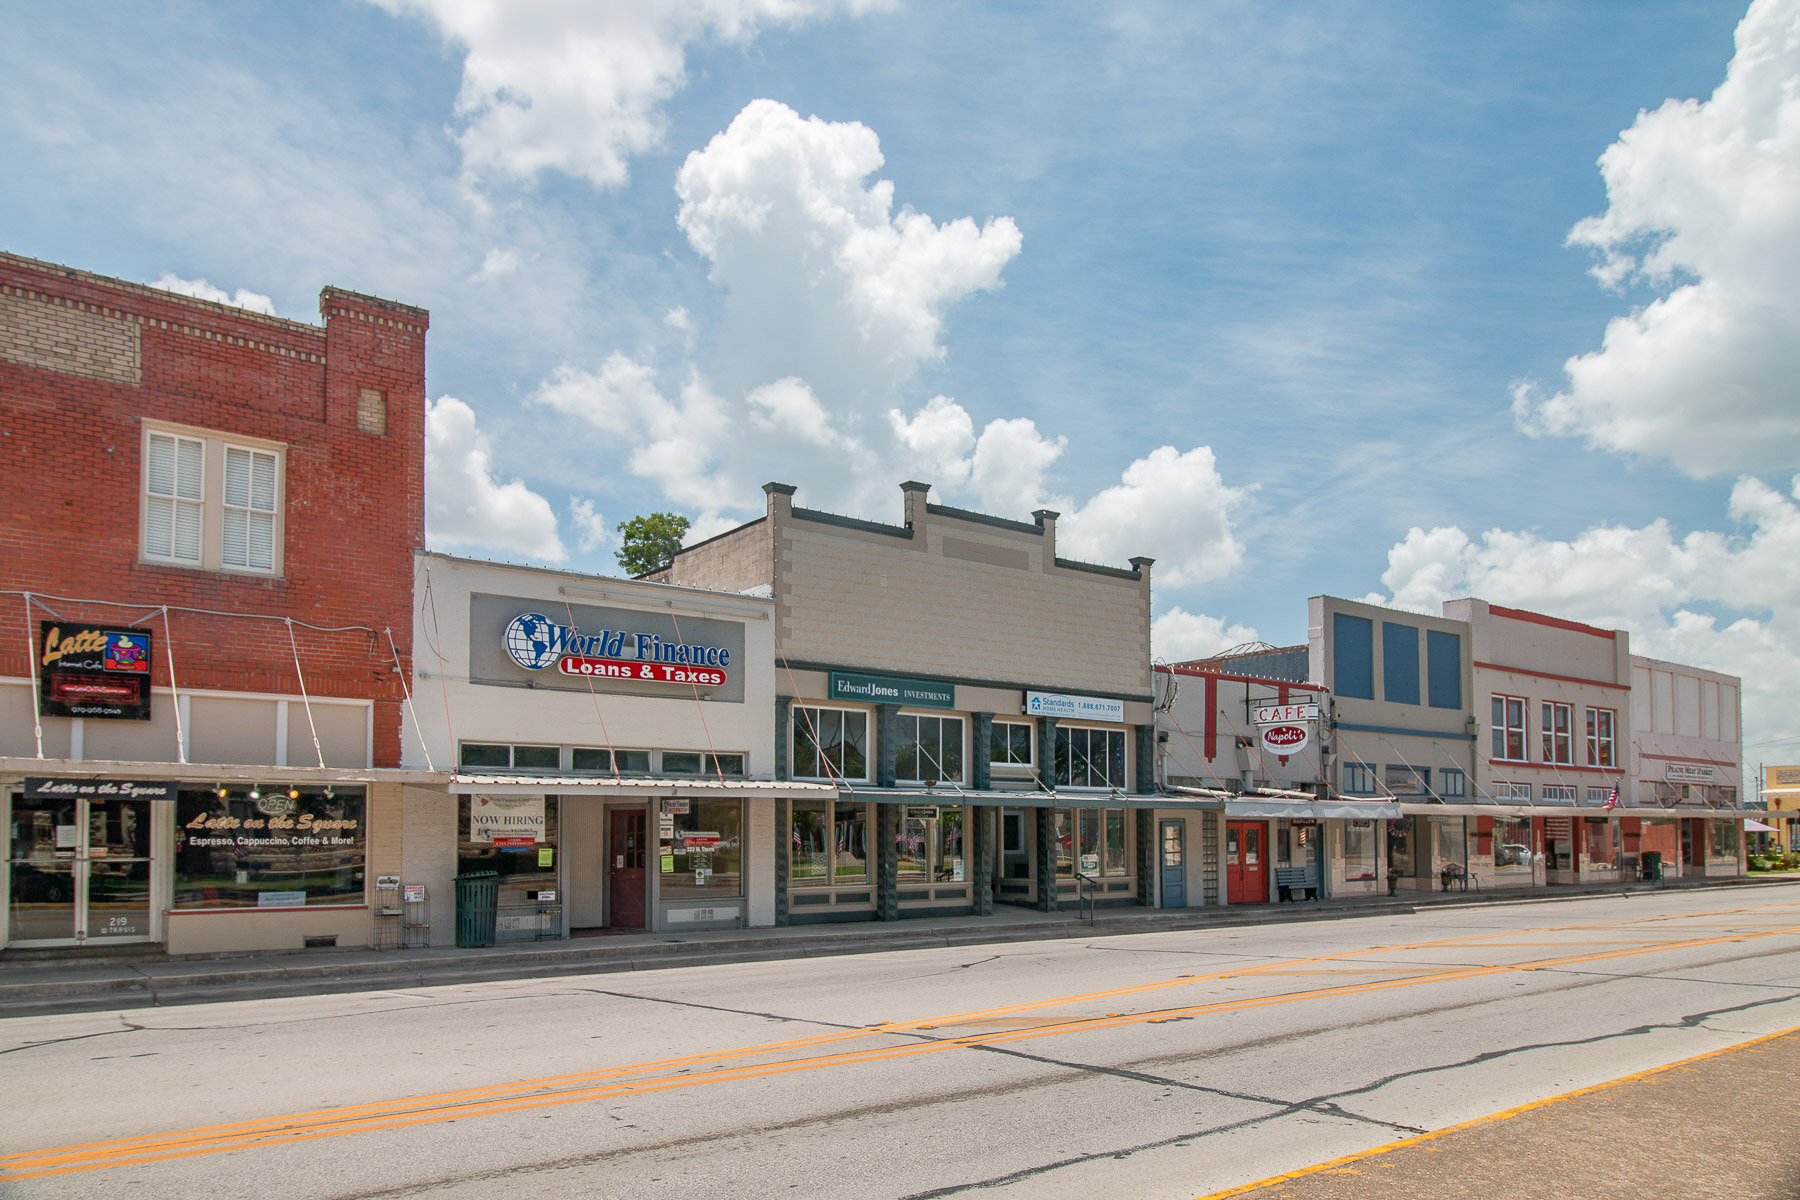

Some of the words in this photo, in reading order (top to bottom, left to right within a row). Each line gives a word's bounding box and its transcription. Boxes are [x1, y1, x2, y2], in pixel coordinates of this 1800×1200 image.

[43, 627, 108, 665] Latte
[548, 624, 626, 657] World
[634, 633, 731, 667] Finance
[566, 658, 632, 677] Loans
[639, 665, 654, 679] &
[662, 666, 721, 685] Taxes
[904, 690, 951, 702] INVESTMENTS
[1042, 697, 1075, 708] Standards
[1259, 705, 1306, 722] CAFE
[1267, 730, 1304, 744] Napoli's
[36, 780, 78, 793] Latte
[79, 785, 96, 794] on
[97, 783, 119, 795] the
[119, 782, 167, 798] Square
[258, 799, 296, 812] OPEN
[186, 812, 241, 830] Latte
[242, 820, 264, 830] on
[267, 815, 293, 830] the
[296, 814, 357, 834] Square
[472, 815, 501, 825] NOW
[503, 815, 544, 825] HIRING
[189, 837, 235, 847] Espresso,
[237, 837, 290, 846] Cappuccino,
[291, 837, 320, 845] Coffee
[110, 917, 128, 926] 219
